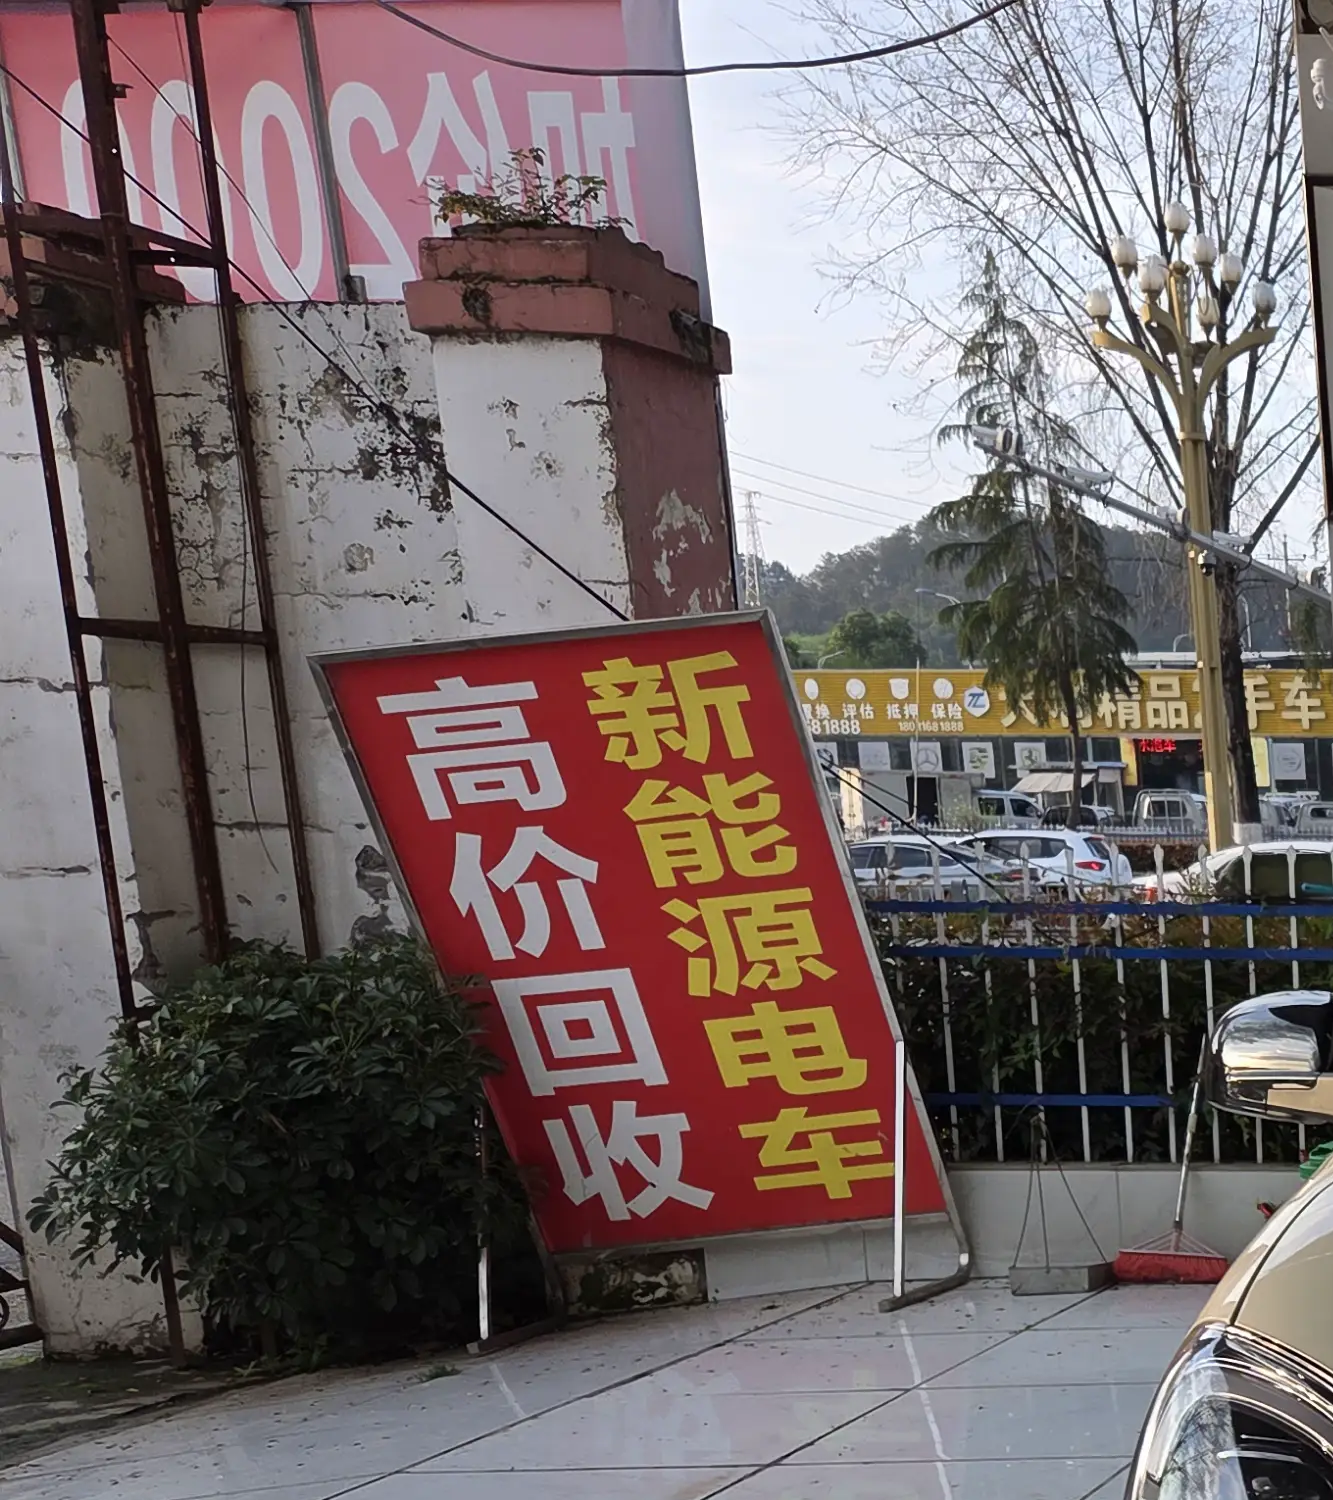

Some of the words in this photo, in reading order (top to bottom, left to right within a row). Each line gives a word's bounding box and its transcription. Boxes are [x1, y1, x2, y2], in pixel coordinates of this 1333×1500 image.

[806, 719, 861, 736] 81888
[842, 702, 875, 720] 评估
[931, 702, 963, 720] 保险
[376, 674, 715, 1221] 高价回收
[581, 649, 895, 1200] 新能源电车
